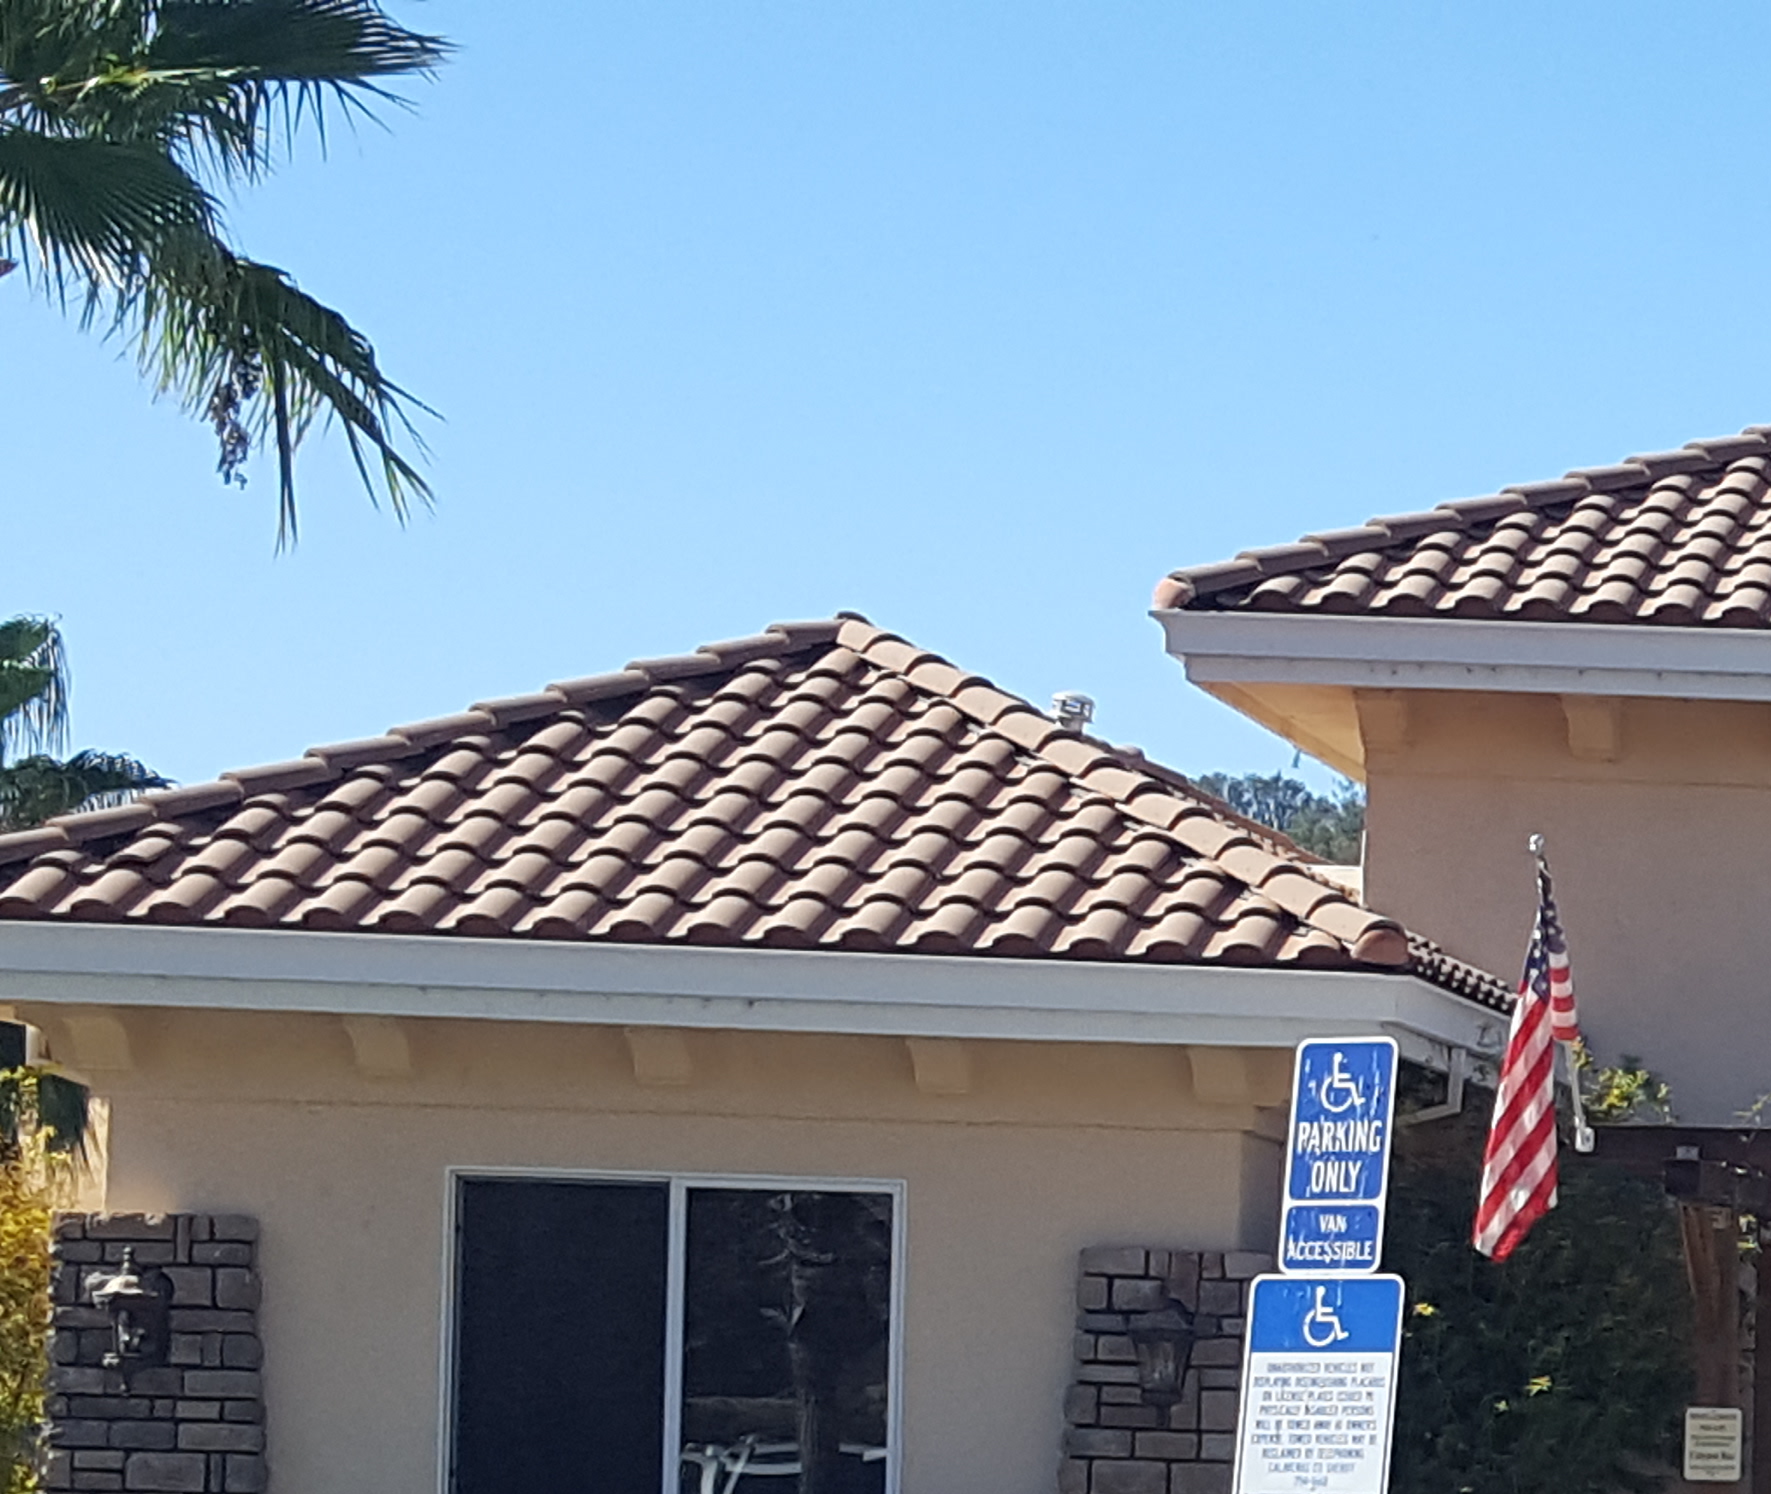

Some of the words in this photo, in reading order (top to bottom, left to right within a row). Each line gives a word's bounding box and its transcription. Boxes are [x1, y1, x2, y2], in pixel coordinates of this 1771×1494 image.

[1297, 1120, 1383, 1153] PARKING
[1312, 1160, 1362, 1193] ONLY
[1319, 1214, 1347, 1233] VAN
[1286, 1239, 1373, 1260] ACCESSIBLE
